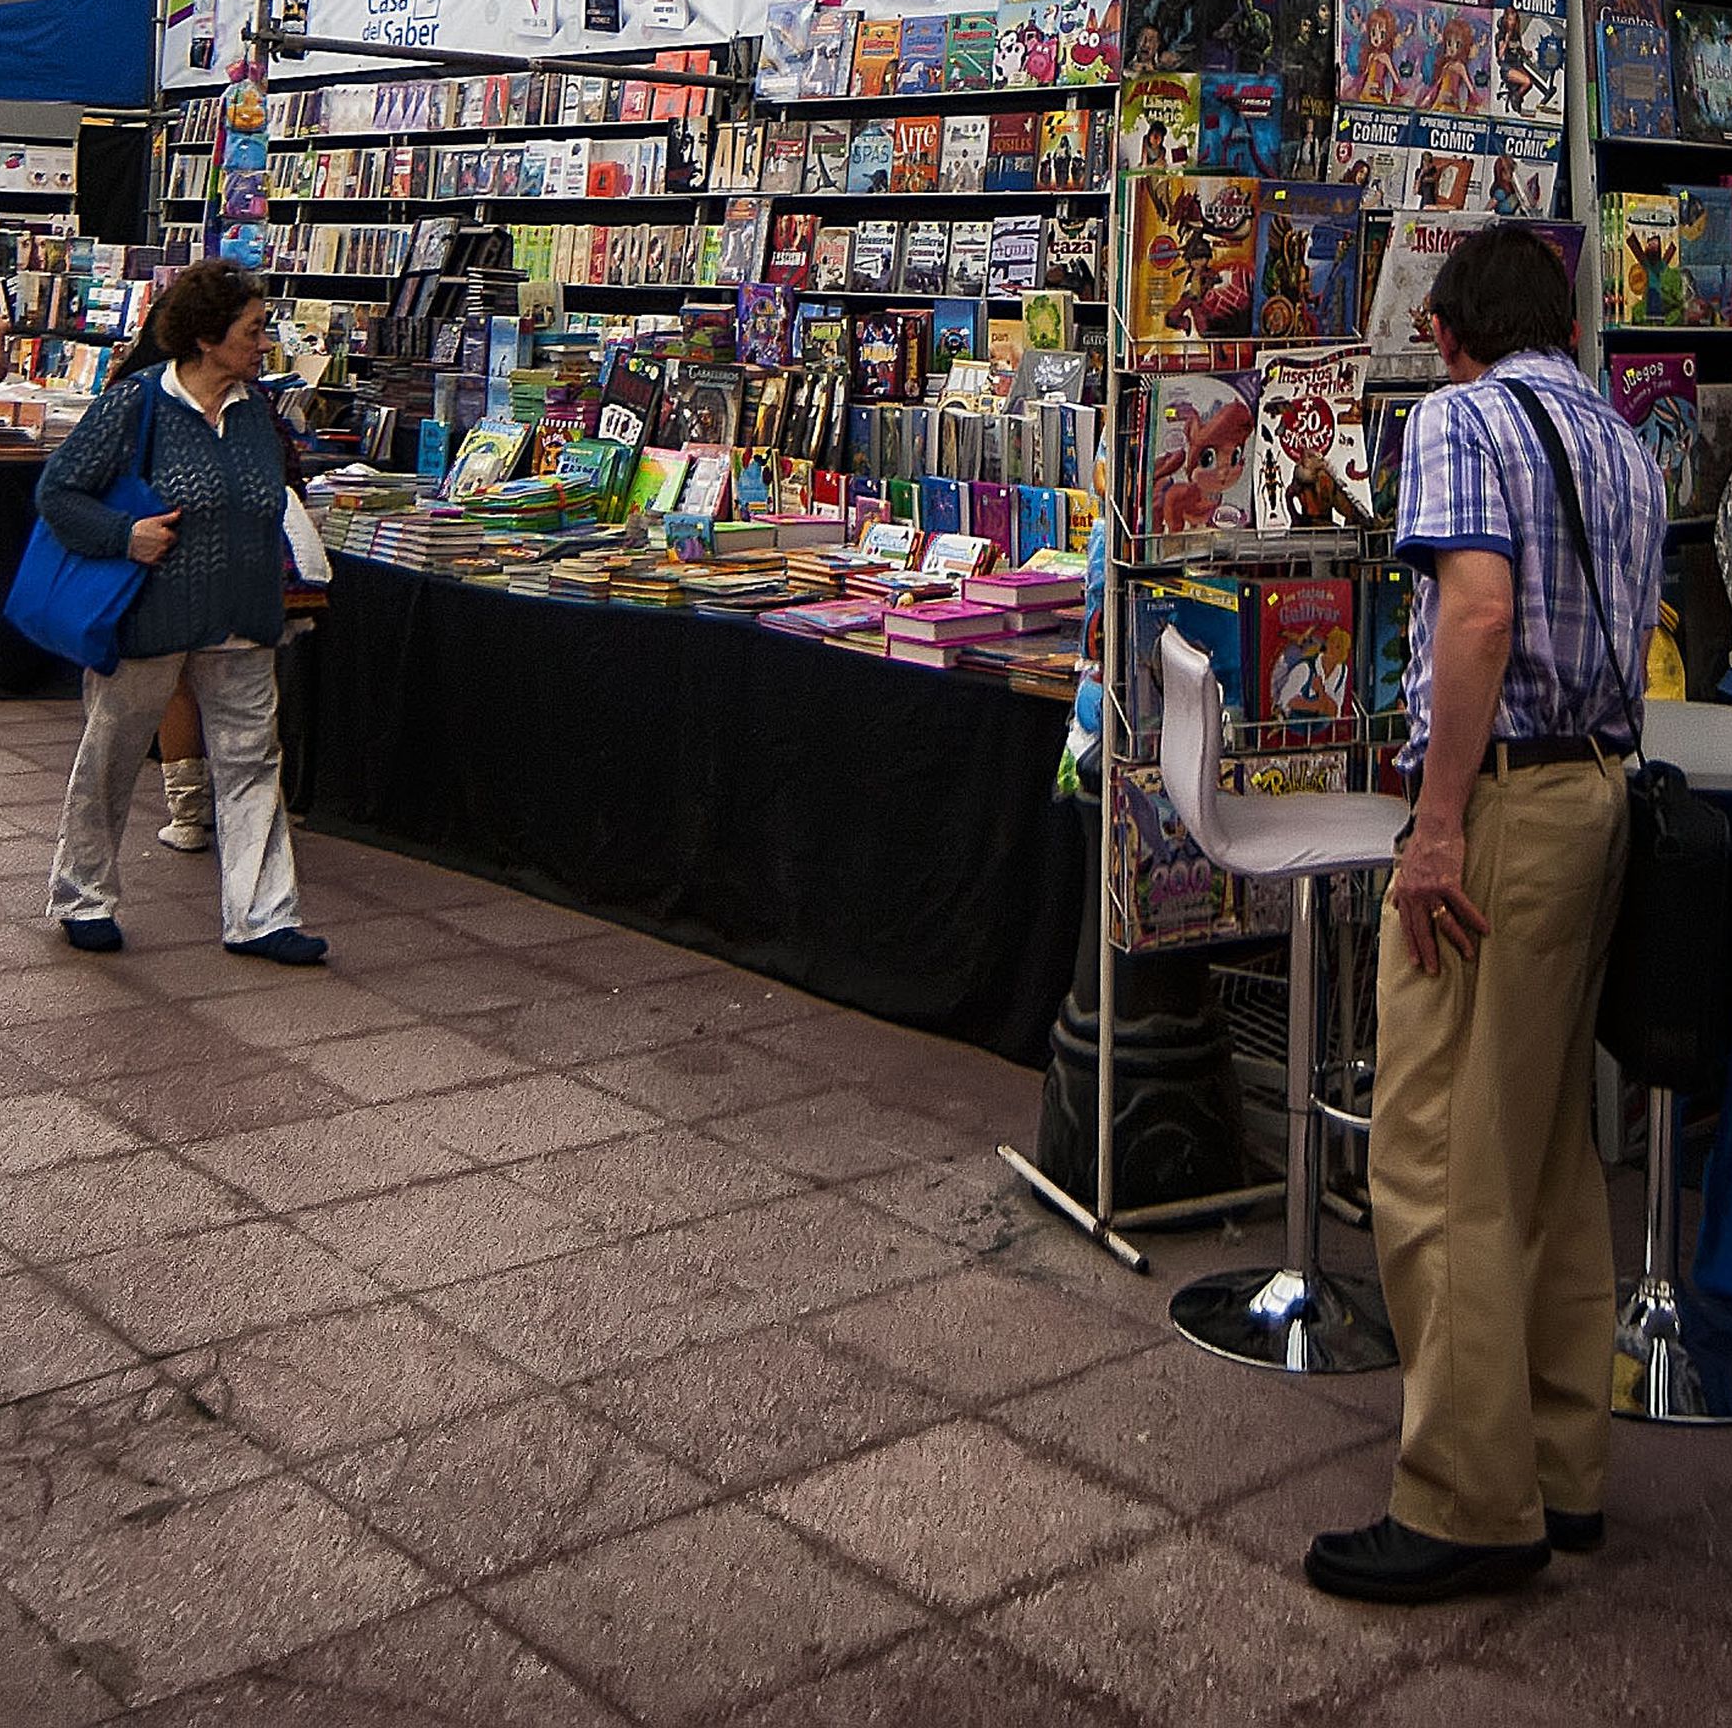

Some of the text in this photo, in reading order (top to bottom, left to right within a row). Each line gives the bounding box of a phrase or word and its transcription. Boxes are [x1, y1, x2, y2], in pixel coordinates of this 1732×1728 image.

[362, 21, 440, 46] del Saber
[1049, 240, 1094, 256] caza
[1277, 365, 1332, 384] Insectos
[1296, 409, 1321, 433] 50
